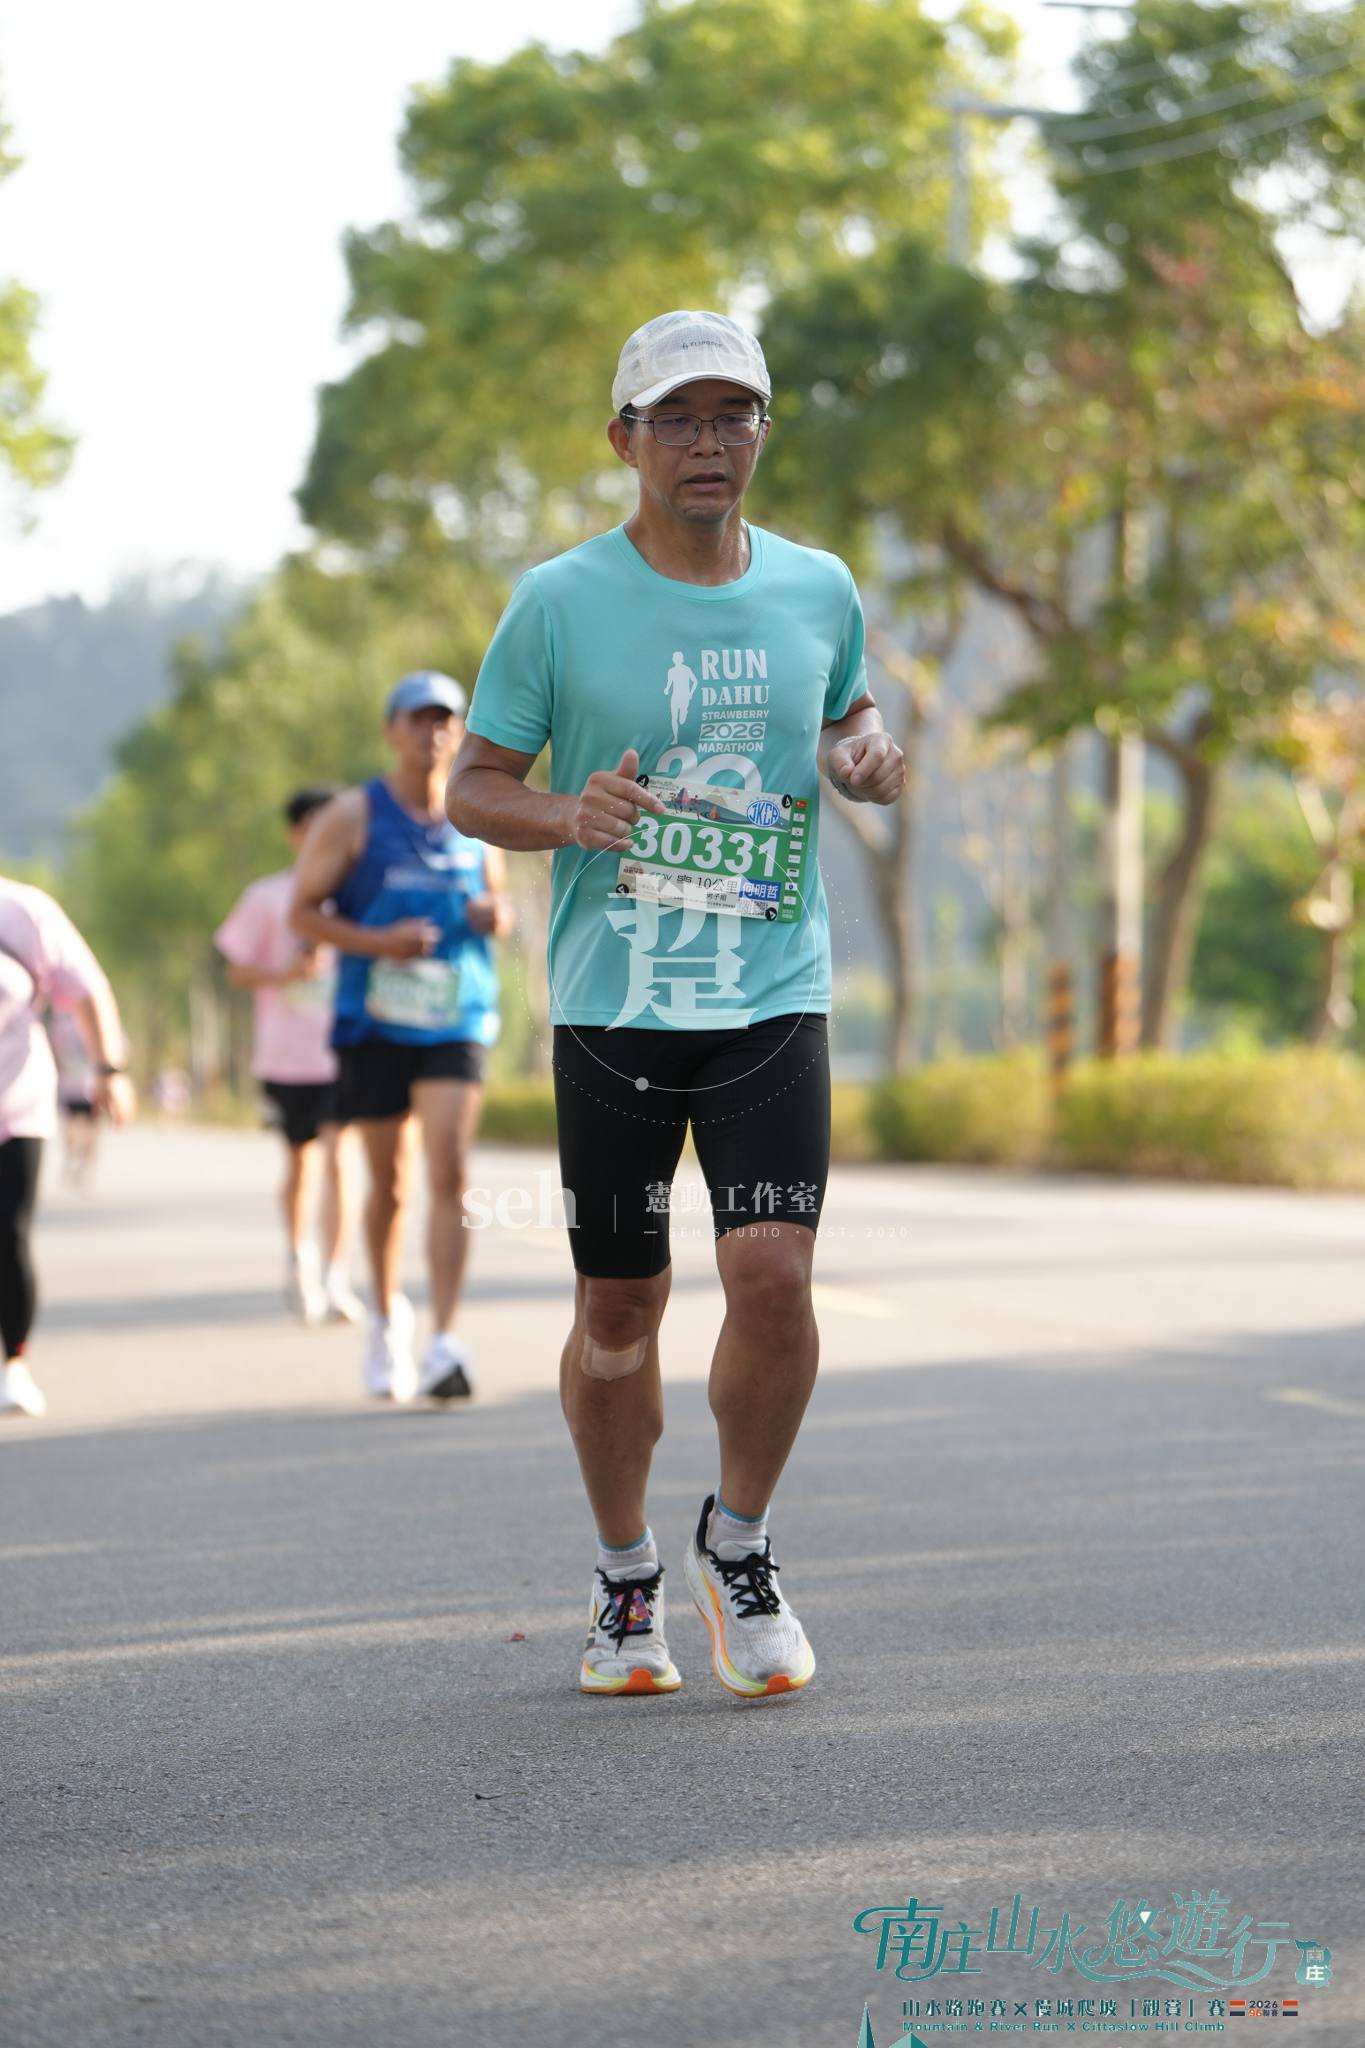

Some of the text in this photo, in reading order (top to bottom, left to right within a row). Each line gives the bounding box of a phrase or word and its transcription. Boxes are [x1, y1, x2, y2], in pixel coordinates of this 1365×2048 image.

[701, 649, 768, 680] RUN
[701, 685, 770, 706] DAHU
[702, 710, 769, 721] STRAWBERRY
[701, 723, 764, 739] 2026
[698, 742, 763, 753] MARATHON
[631, 816, 778, 878] 30331
[697, 877, 738, 895] 10公里
